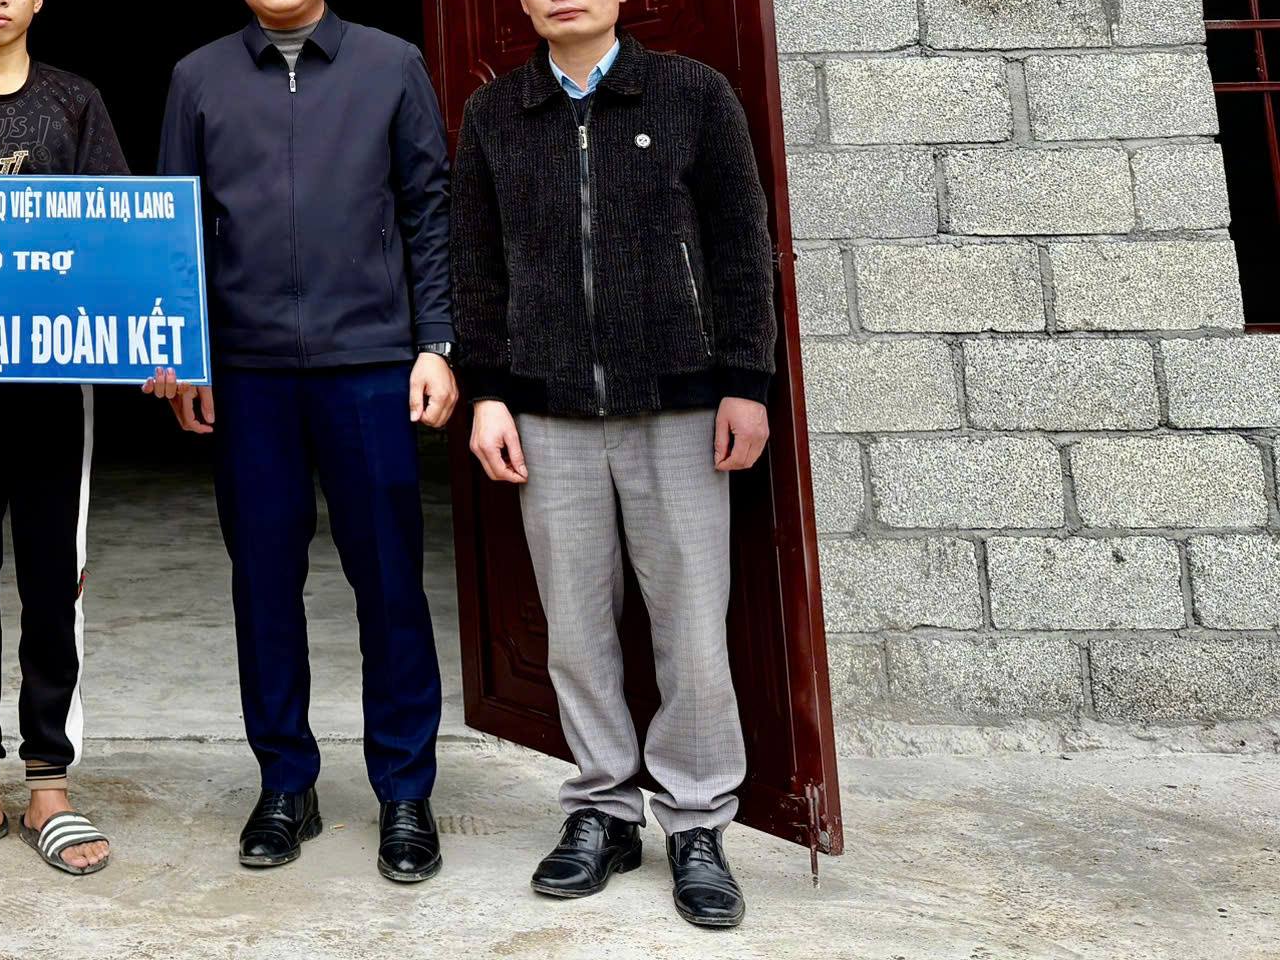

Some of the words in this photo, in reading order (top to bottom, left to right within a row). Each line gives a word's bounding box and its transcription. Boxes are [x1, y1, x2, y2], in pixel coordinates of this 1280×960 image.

[10, 186, 43, 224] VIỆT
[45, 191, 82, 219] NAM
[85, 186, 107, 219] XÃ
[109, 191, 132, 223] HẠ
[134, 191, 175, 220] LANG
[12, 249, 75, 275] TRỢ
[30, 306, 119, 365] ĐOÀN
[127, 297, 186, 365] KẾT
